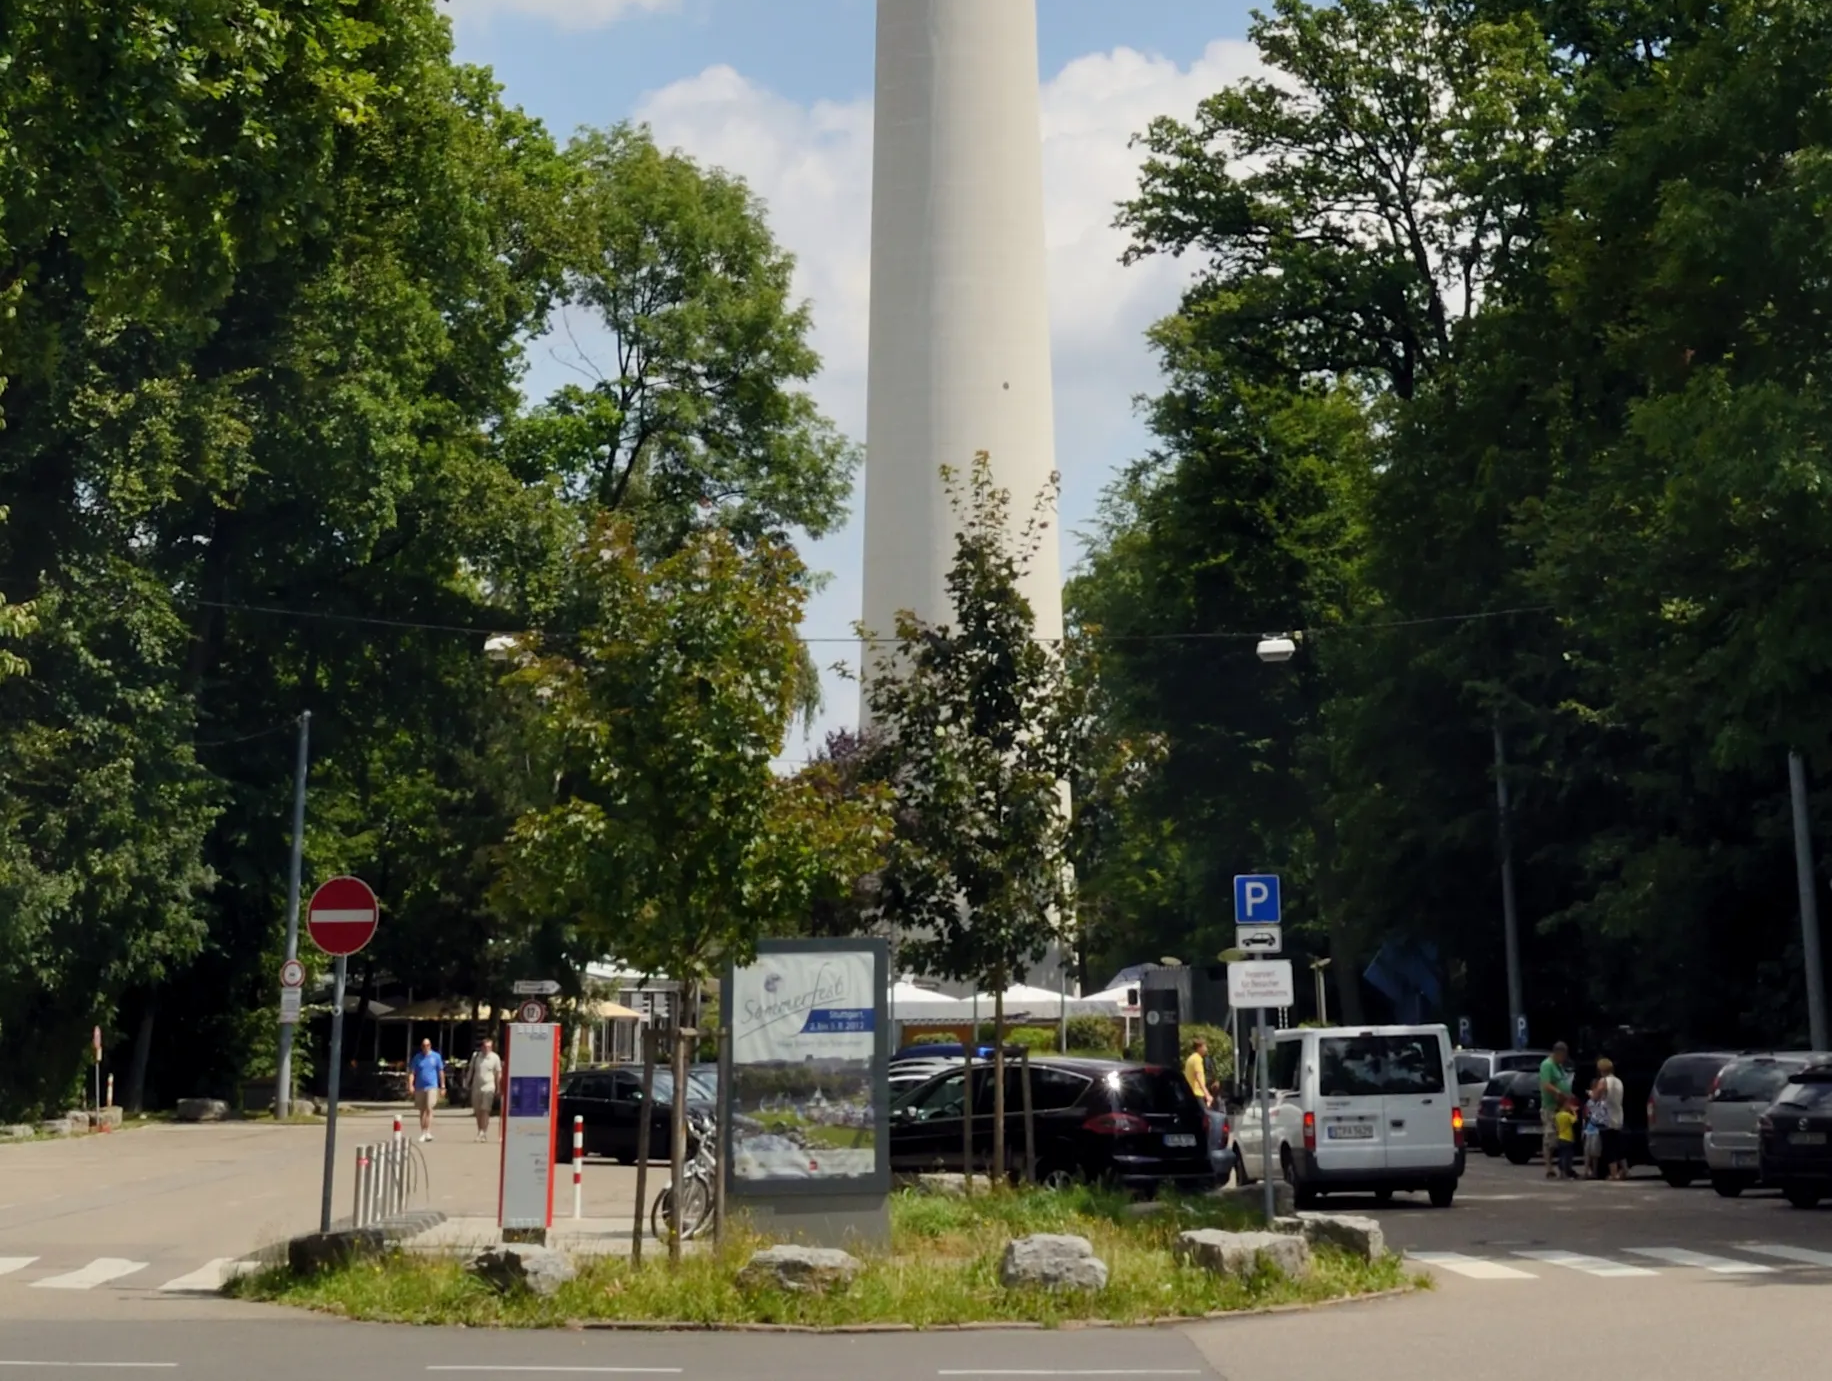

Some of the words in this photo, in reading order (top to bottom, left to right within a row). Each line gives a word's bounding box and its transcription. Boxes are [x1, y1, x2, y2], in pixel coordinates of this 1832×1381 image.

[1245, 881, 1269, 917] P
[740, 961, 846, 1025] Sommerfest
[1459, 1018, 1469, 1036] P
[1517, 1017, 1527, 1035] P
